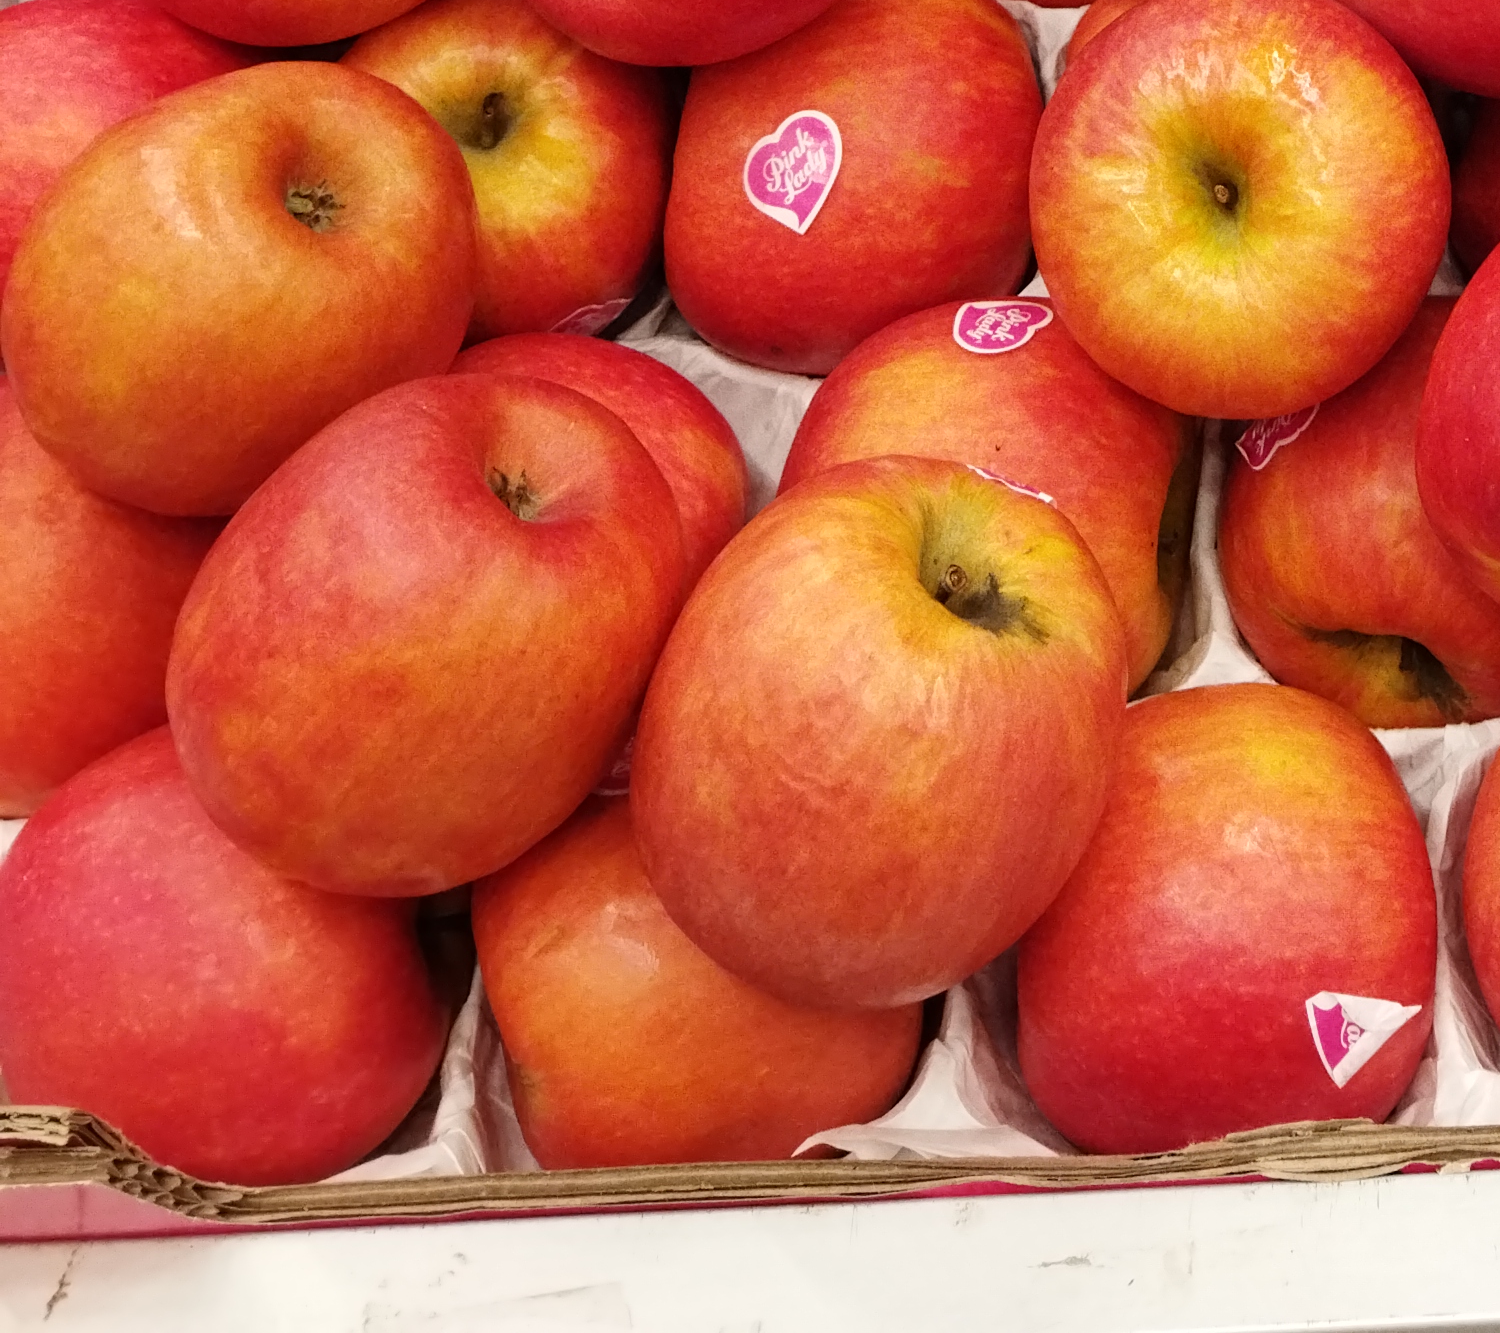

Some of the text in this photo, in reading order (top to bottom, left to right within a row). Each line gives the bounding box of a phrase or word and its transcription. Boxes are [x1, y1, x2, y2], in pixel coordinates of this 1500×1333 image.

[763, 127, 815, 193] Pink
[779, 146, 827, 206] Lady
[966, 308, 1007, 340] Lady
[990, 308, 1032, 341] Pink
